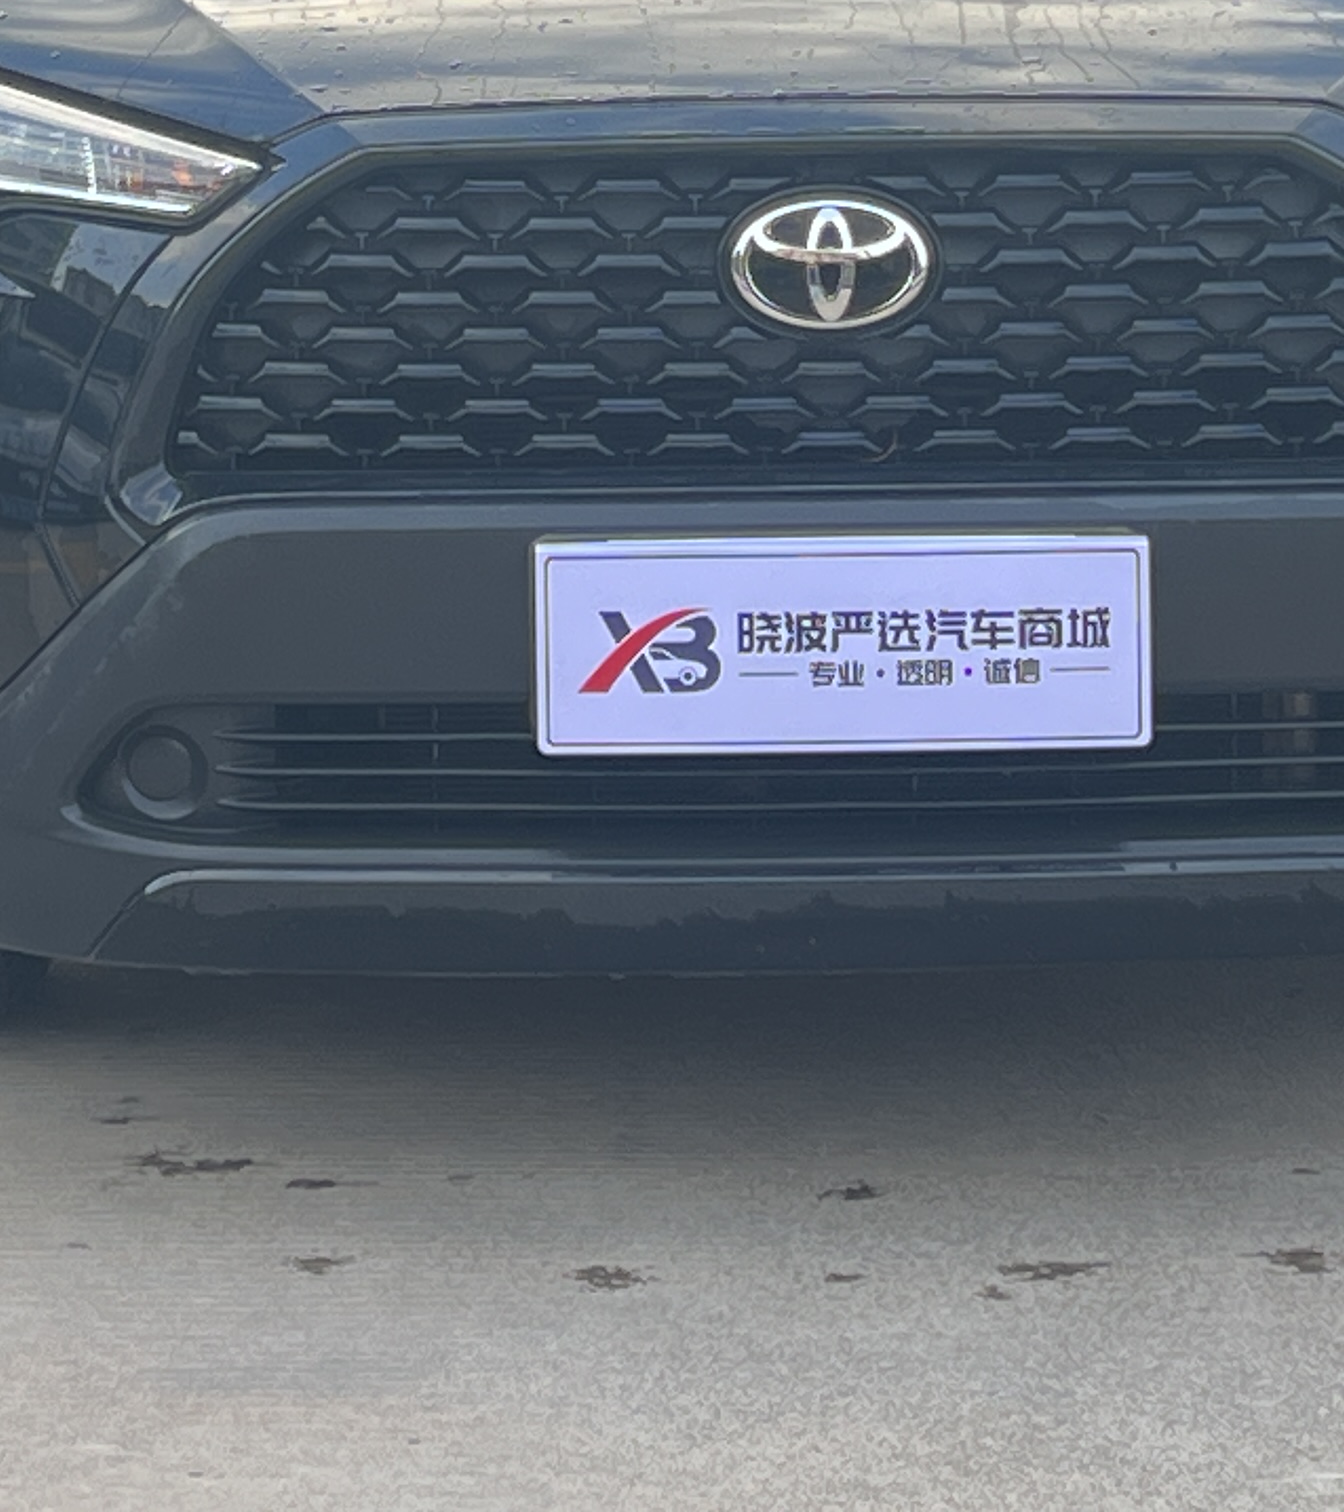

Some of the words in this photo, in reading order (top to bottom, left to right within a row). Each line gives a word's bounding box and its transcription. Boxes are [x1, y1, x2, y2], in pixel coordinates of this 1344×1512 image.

[736, 606, 1111, 654] 晓波严选汽车商城
